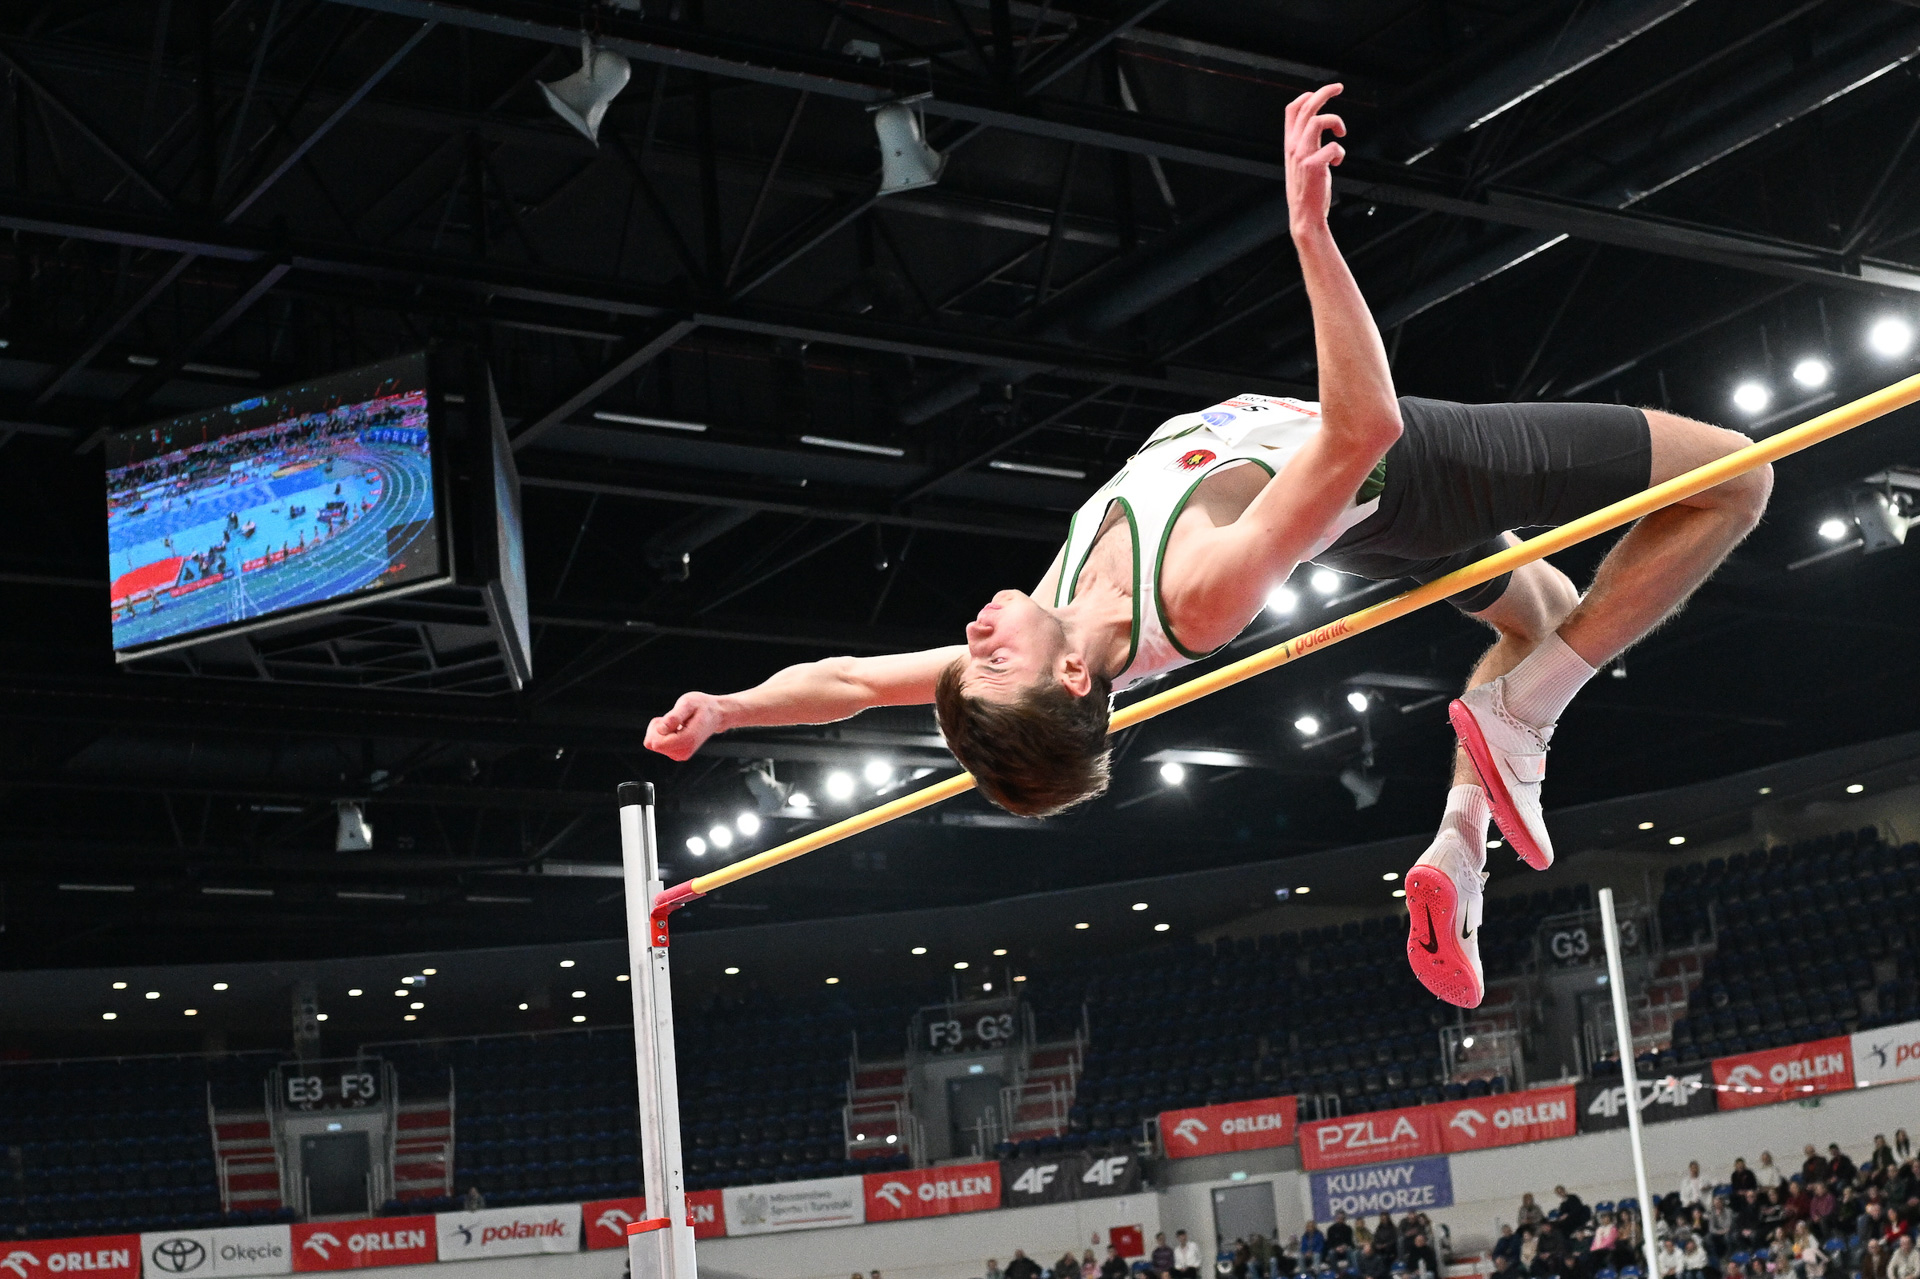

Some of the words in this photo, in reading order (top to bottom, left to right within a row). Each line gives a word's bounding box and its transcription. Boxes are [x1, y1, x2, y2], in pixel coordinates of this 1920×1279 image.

[1295, 619, 1350, 655] polanik
[1552, 929, 1589, 959] G3
[930, 1020, 962, 1046] F3
[977, 1014, 1014, 1041] G3
[1769, 1052, 1844, 1084] ORLEN
[288, 1076, 323, 1102] E3
[341, 1073, 375, 1099] F3
[1221, 1113, 1282, 1135] ORLEN
[1493, 1101, 1566, 1129] ORLEN
[1317, 1116, 1418, 1152] PZLA
[917, 1176, 992, 1201] ORLEN
[1012, 1164, 1058, 1194] 4F
[1082, 1156, 1128, 1186] 4F
[1326, 1165, 1414, 1195] KUJAWY
[1329, 1185, 1435, 1217] POMORZE
[347, 1230, 426, 1253] ORLEN
[481, 1218, 565, 1246] polanik
[47, 1248, 130, 1273] ORLEN
[221, 1243, 283, 1262] Okęcie
